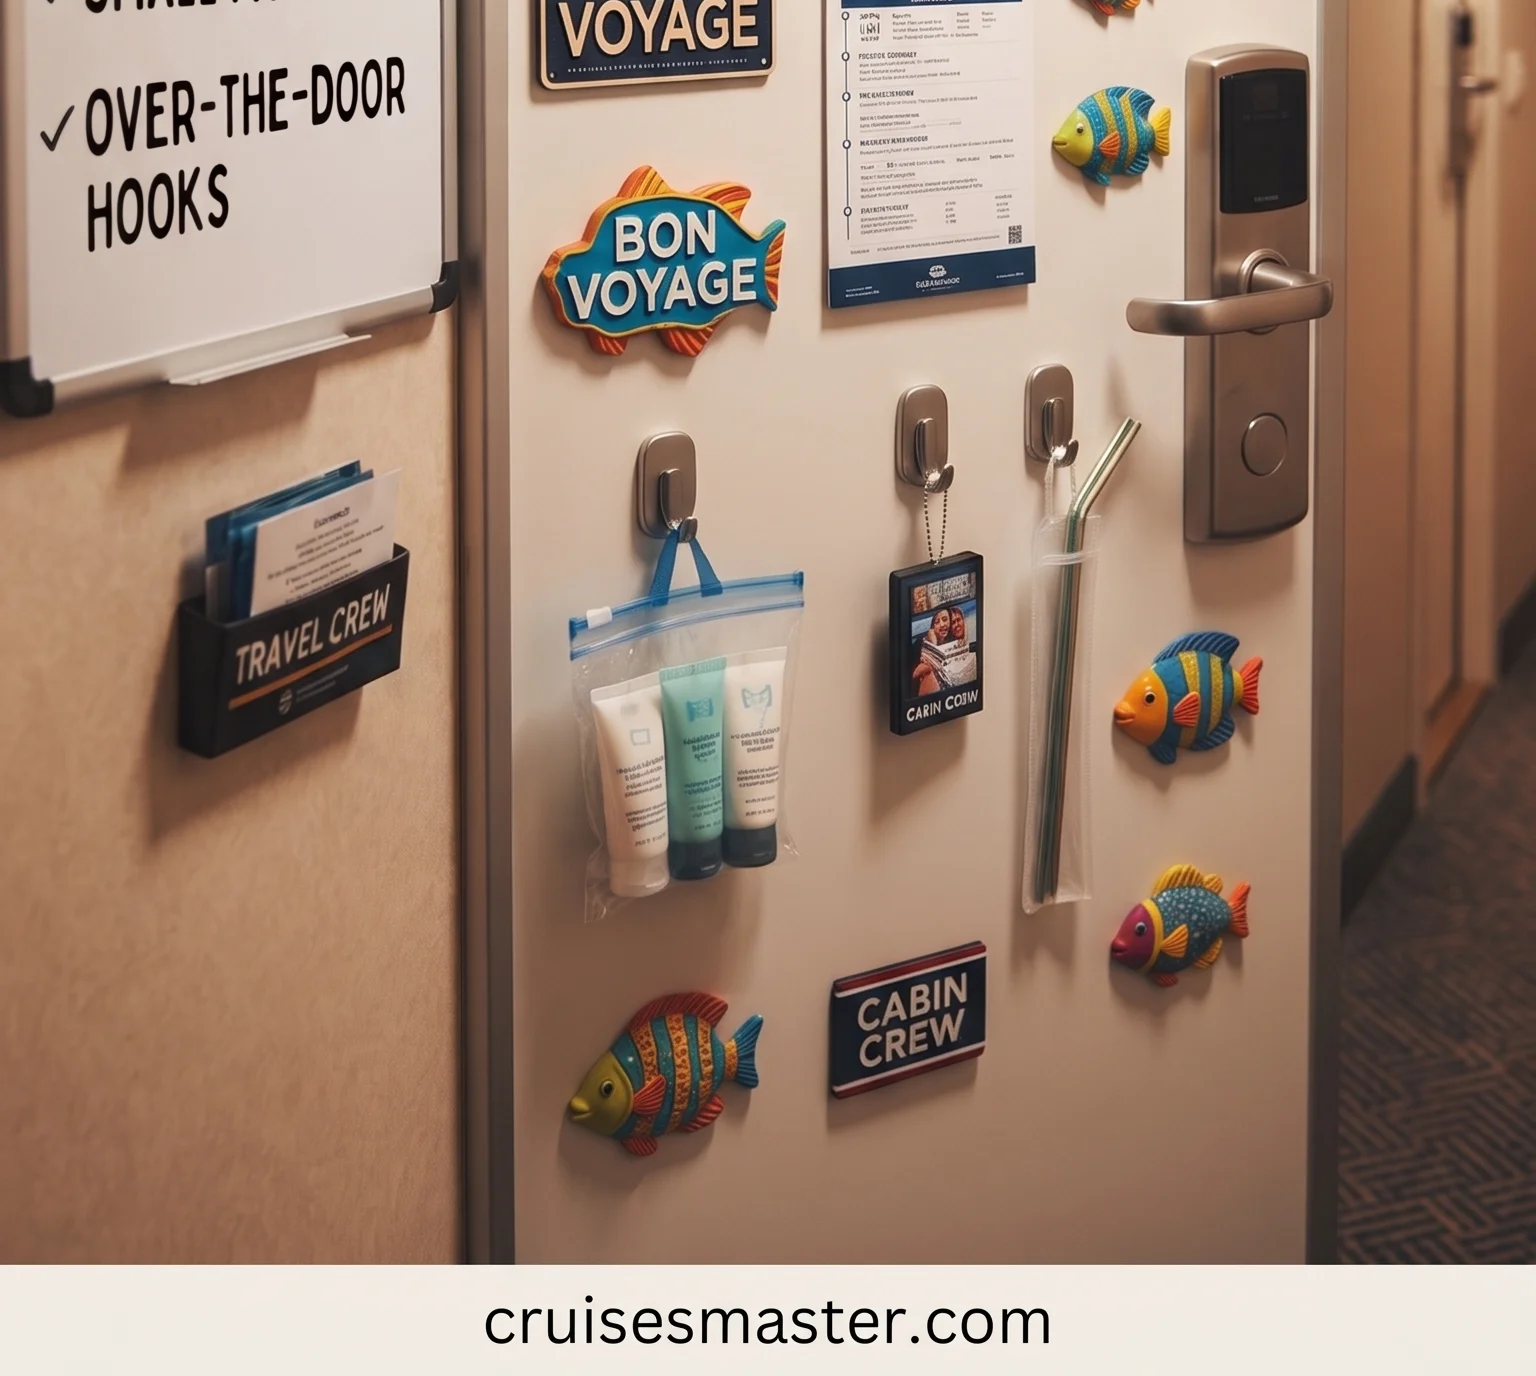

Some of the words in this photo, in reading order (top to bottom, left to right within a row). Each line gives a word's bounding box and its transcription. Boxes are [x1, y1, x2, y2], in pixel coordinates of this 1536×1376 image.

[85, 56, 405, 156] OVER-THE-DOOR
[88, 163, 229, 252] HOOKS
[614, 210, 717, 263] BON
[567, 258, 757, 320] VOYAGE
[235, 616, 324, 685] TRAVEL
[328, 583, 391, 645] CREW
[857, 972, 968, 1032] CABIN
[858, 1008, 966, 1068] CREW
